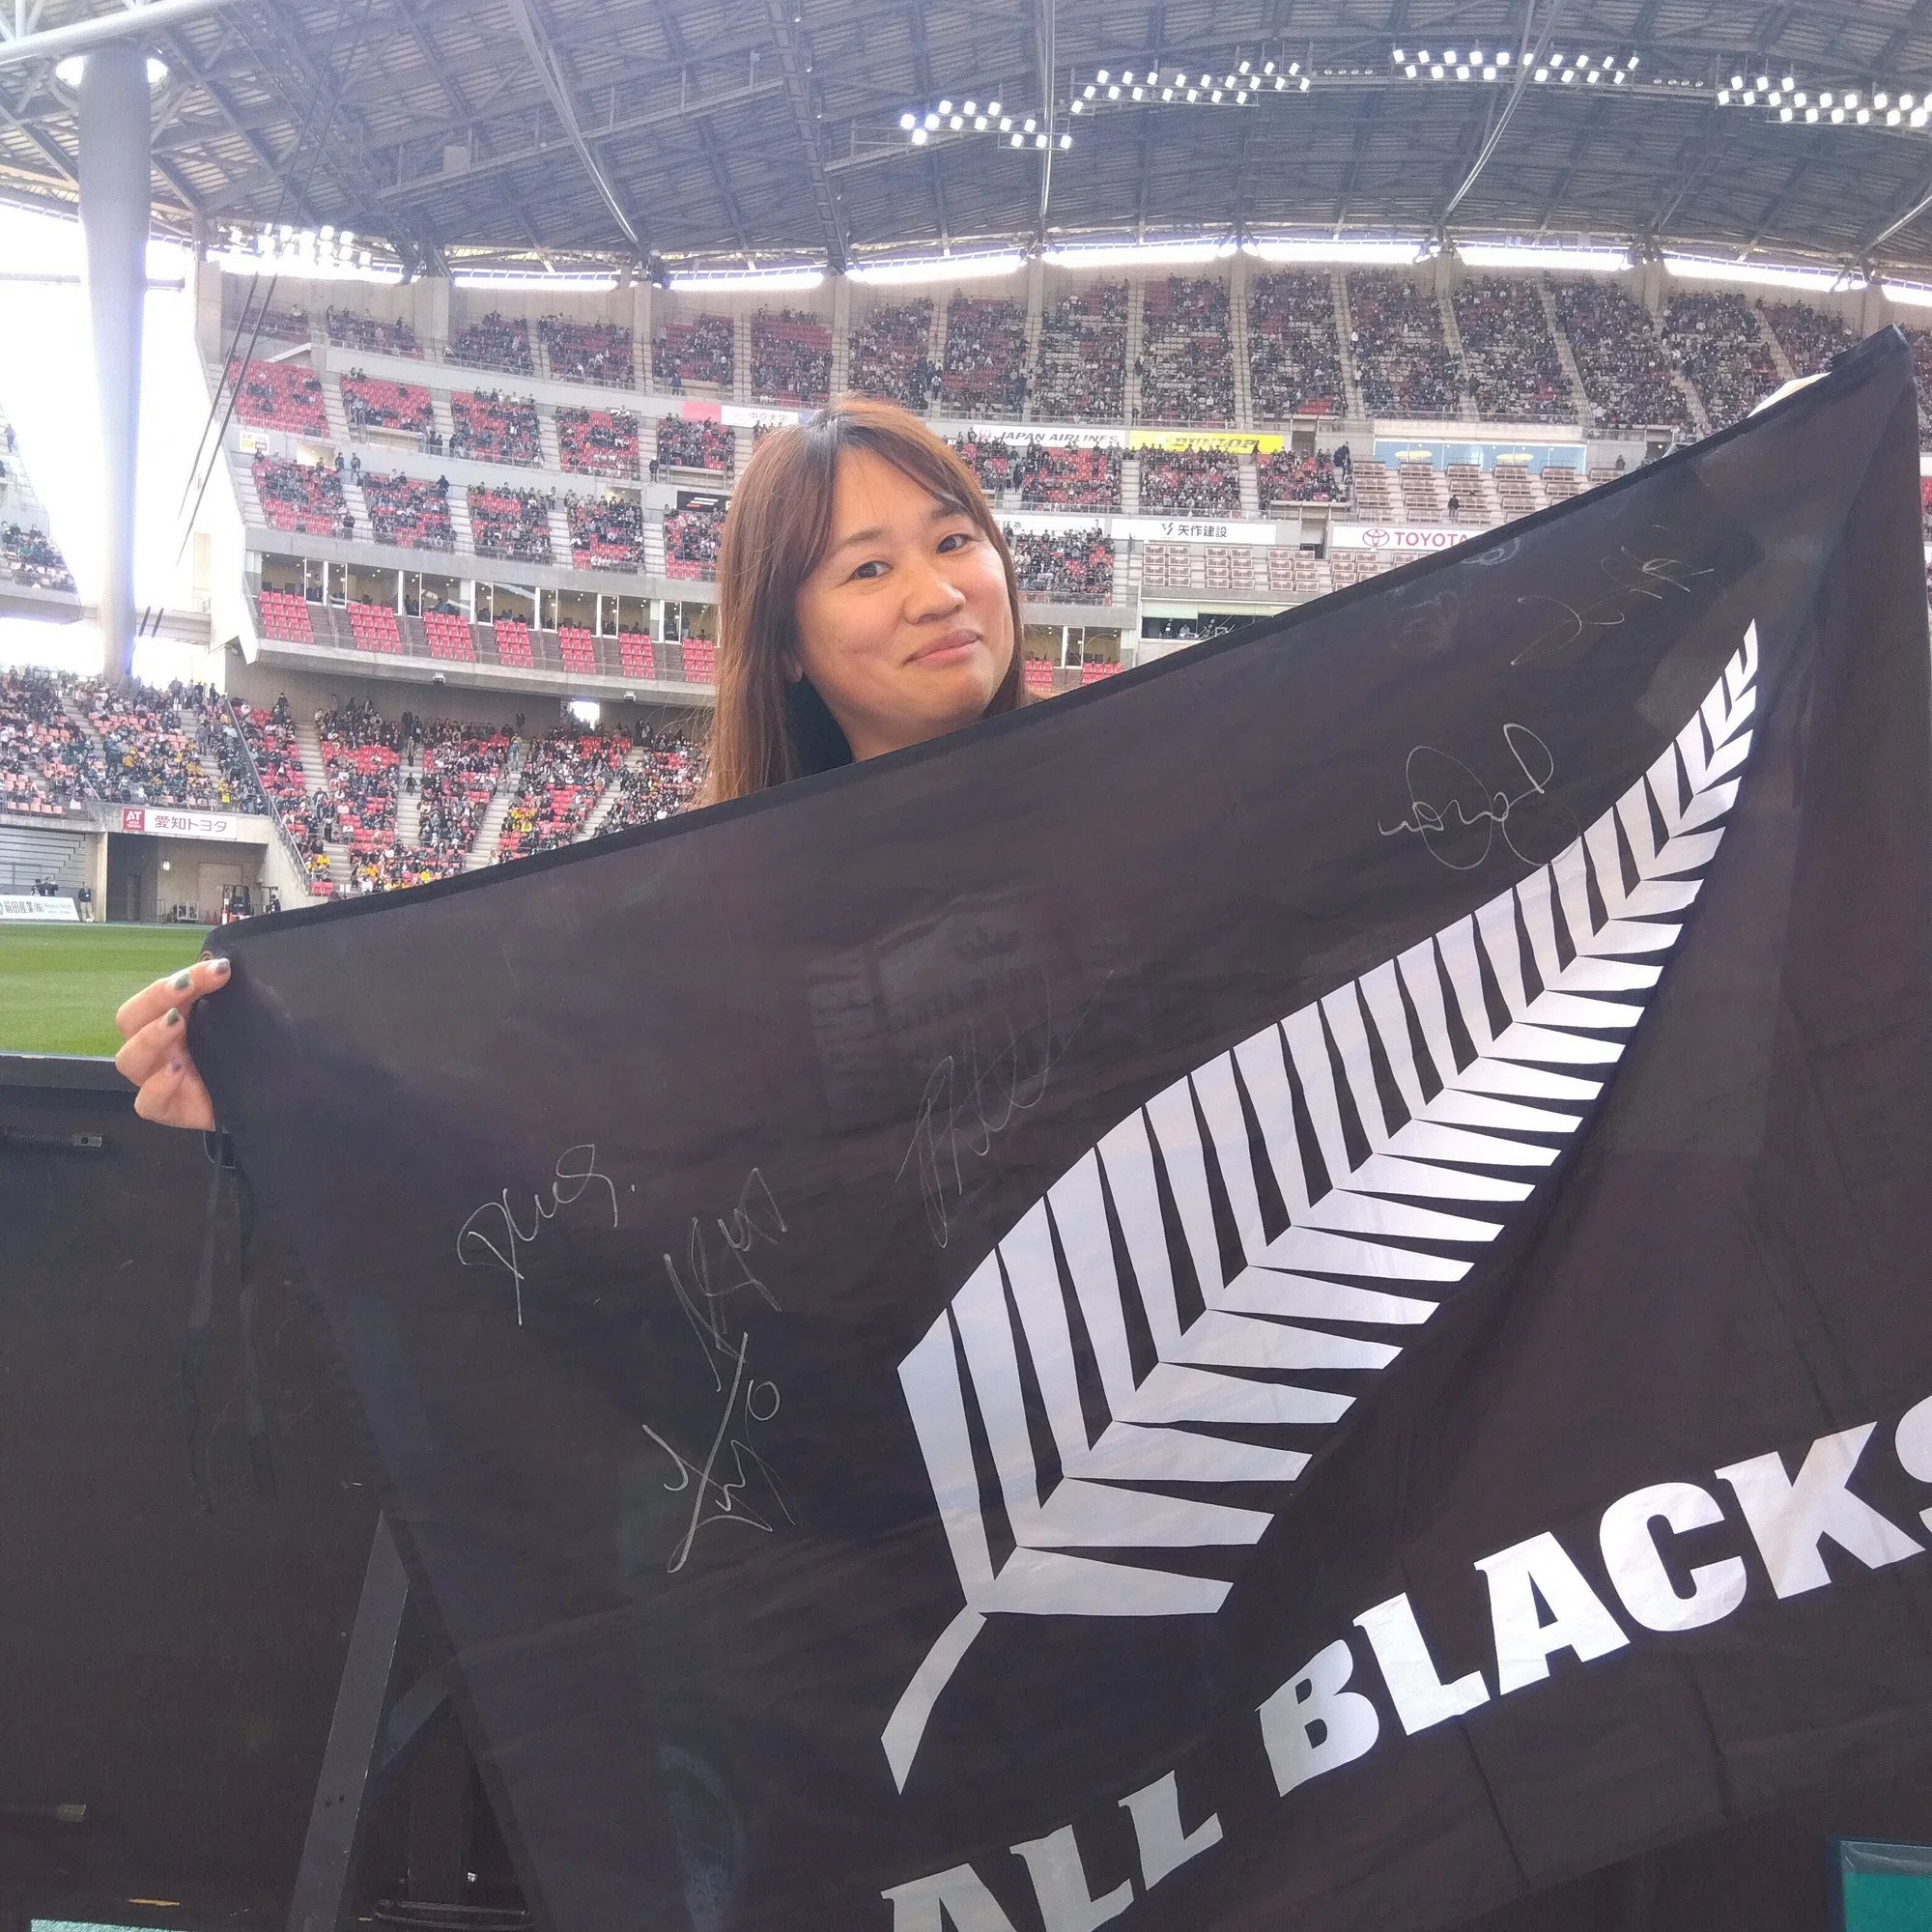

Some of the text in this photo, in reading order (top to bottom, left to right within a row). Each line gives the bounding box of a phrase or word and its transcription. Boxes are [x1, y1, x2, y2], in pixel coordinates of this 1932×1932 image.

[751, 412, 786, 421] 中京大学
[1000, 432, 1118, 442] JAPAN AIRLINES
[1173, 437, 1257, 448] DUNLOP
[1178, 525, 1227, 538] 矢作建設
[126, 810, 142, 822] AT
[155, 815, 227, 832] 愛知トヨタ
